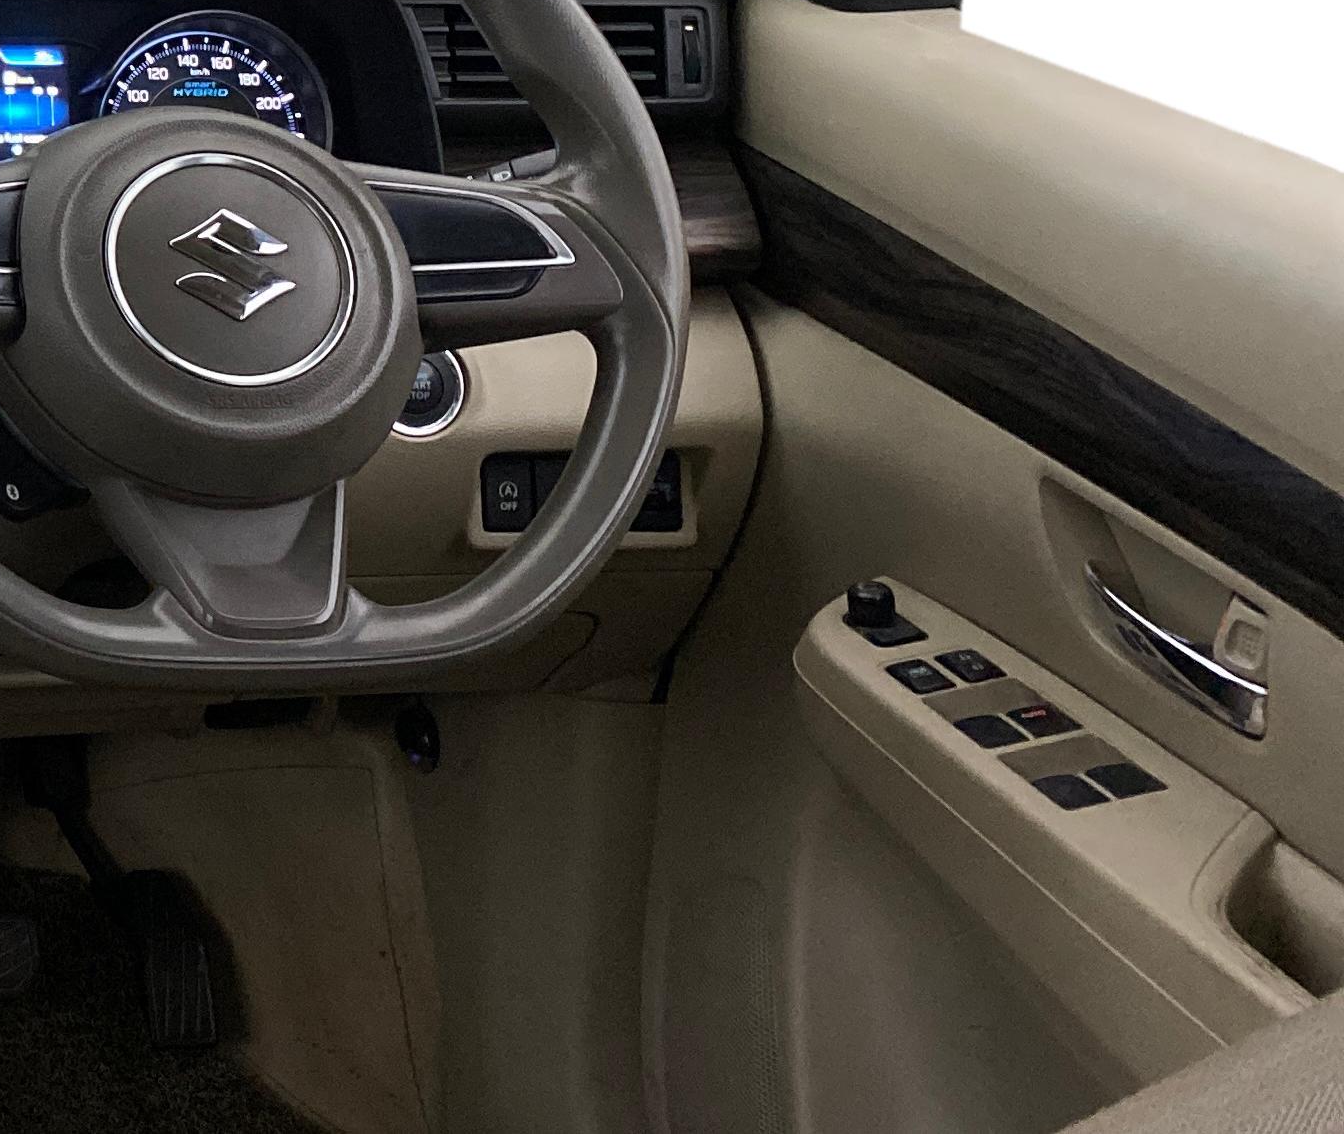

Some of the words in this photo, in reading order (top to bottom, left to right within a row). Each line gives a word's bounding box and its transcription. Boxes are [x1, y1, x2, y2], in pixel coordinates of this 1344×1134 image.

[177, 54, 199, 67] 140
[211, 56, 233, 70] 160
[147, 67, 169, 81] 120
[190, 68, 211, 76] km/h
[184, 81, 216, 89] smart
[238, 73, 260, 86] 180
[127, 89, 149, 103] 100
[173, 88, 229, 97] HYBRID
[256, 96, 282, 110] 200
[500, 501, 518, 512] OFF
